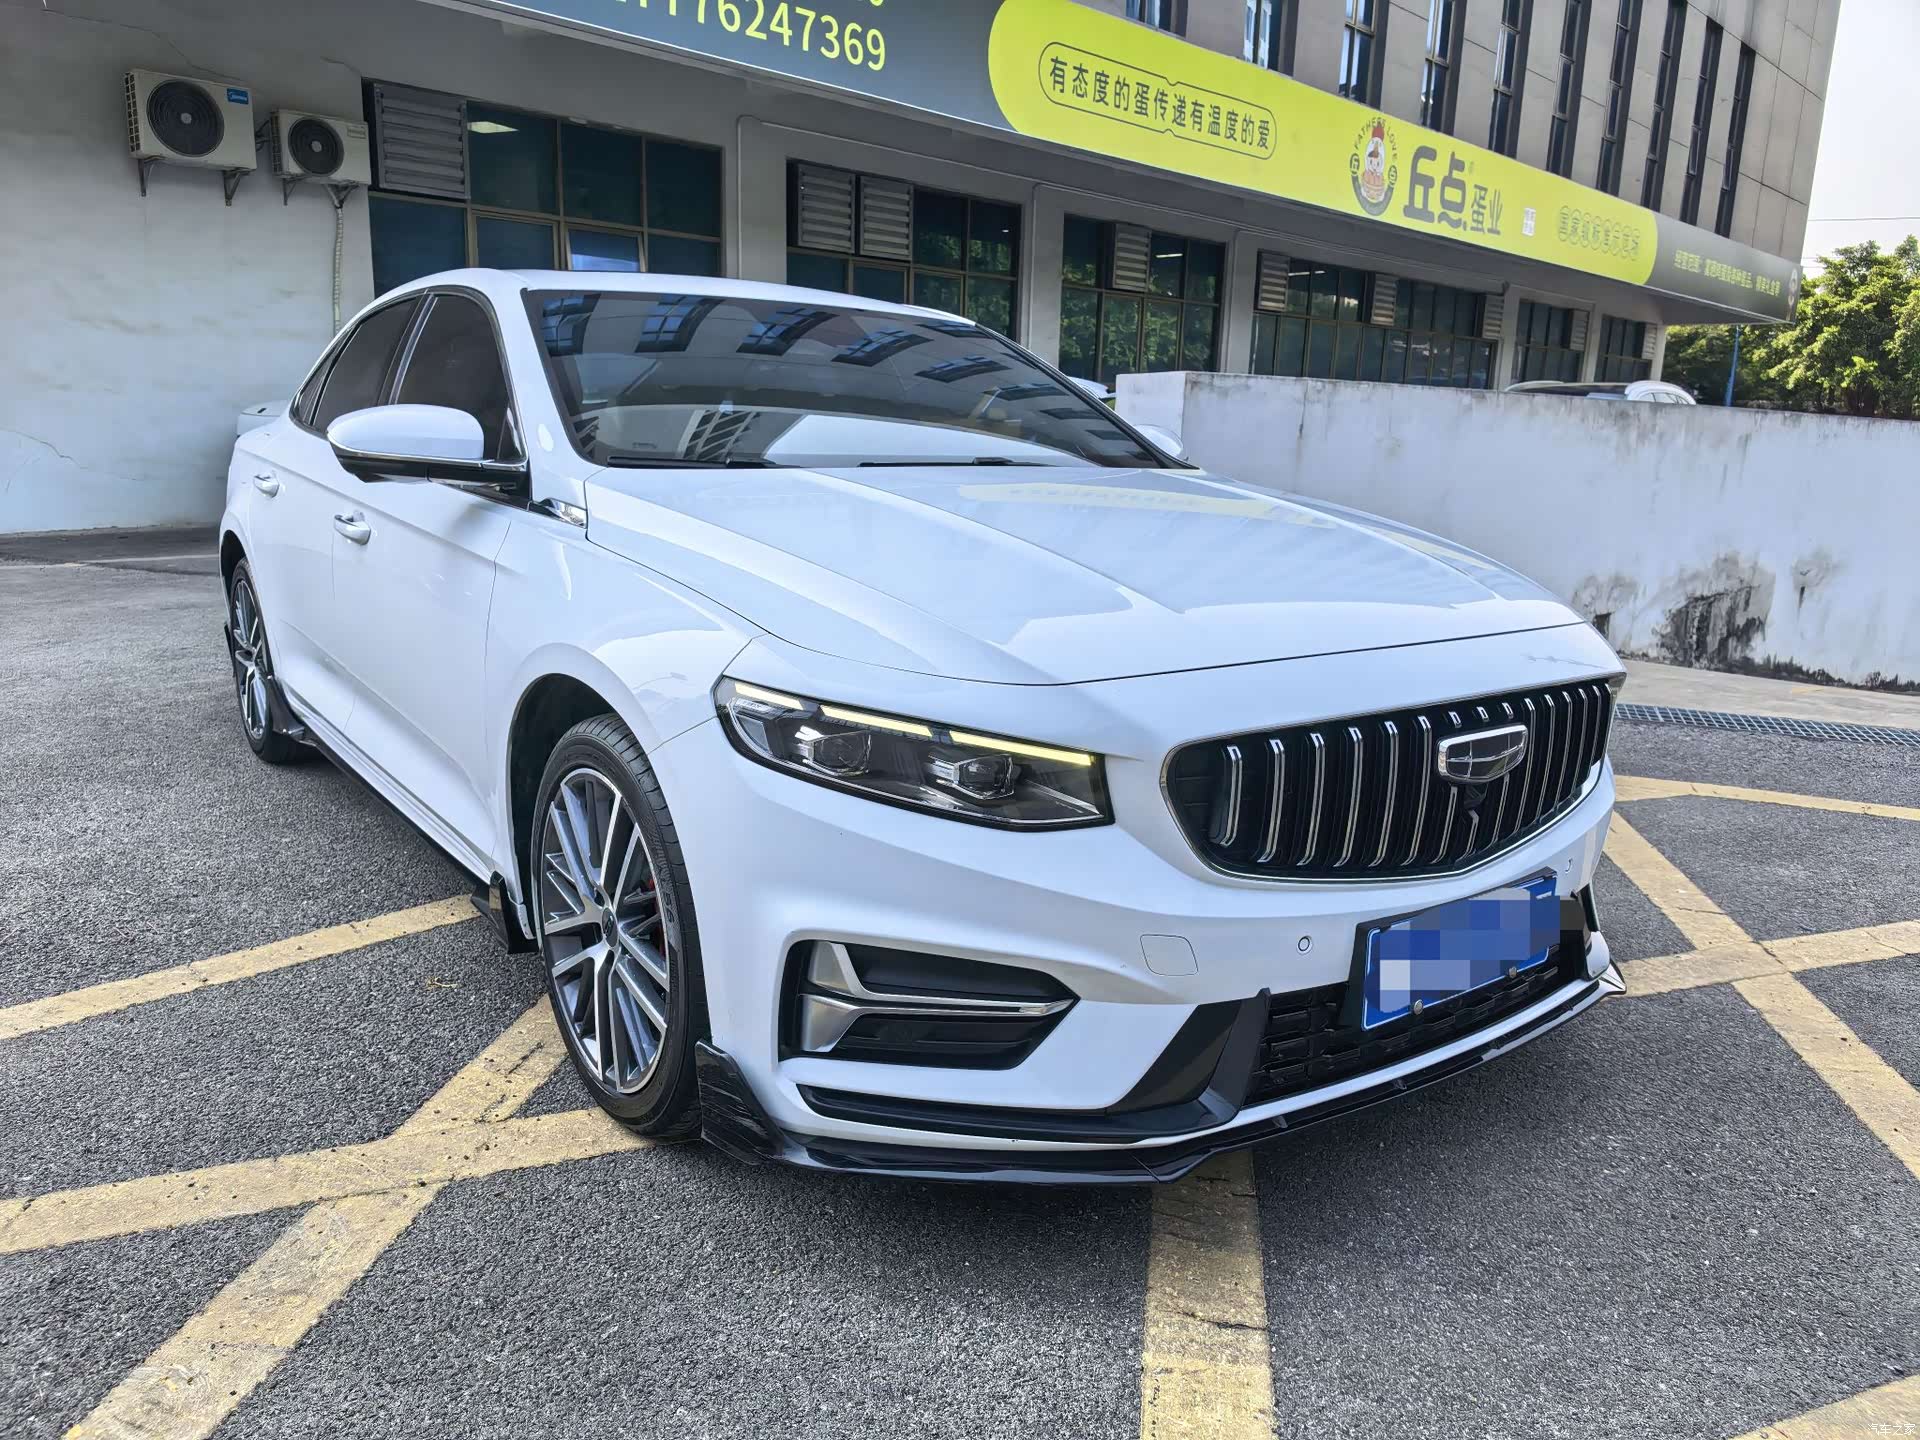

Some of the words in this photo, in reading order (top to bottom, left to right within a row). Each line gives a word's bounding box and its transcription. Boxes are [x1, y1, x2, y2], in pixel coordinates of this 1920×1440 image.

[616, 0, 886, 71] 6247369
[1049, 56, 1271, 150] 有态度的蛋传递有温度的爱
